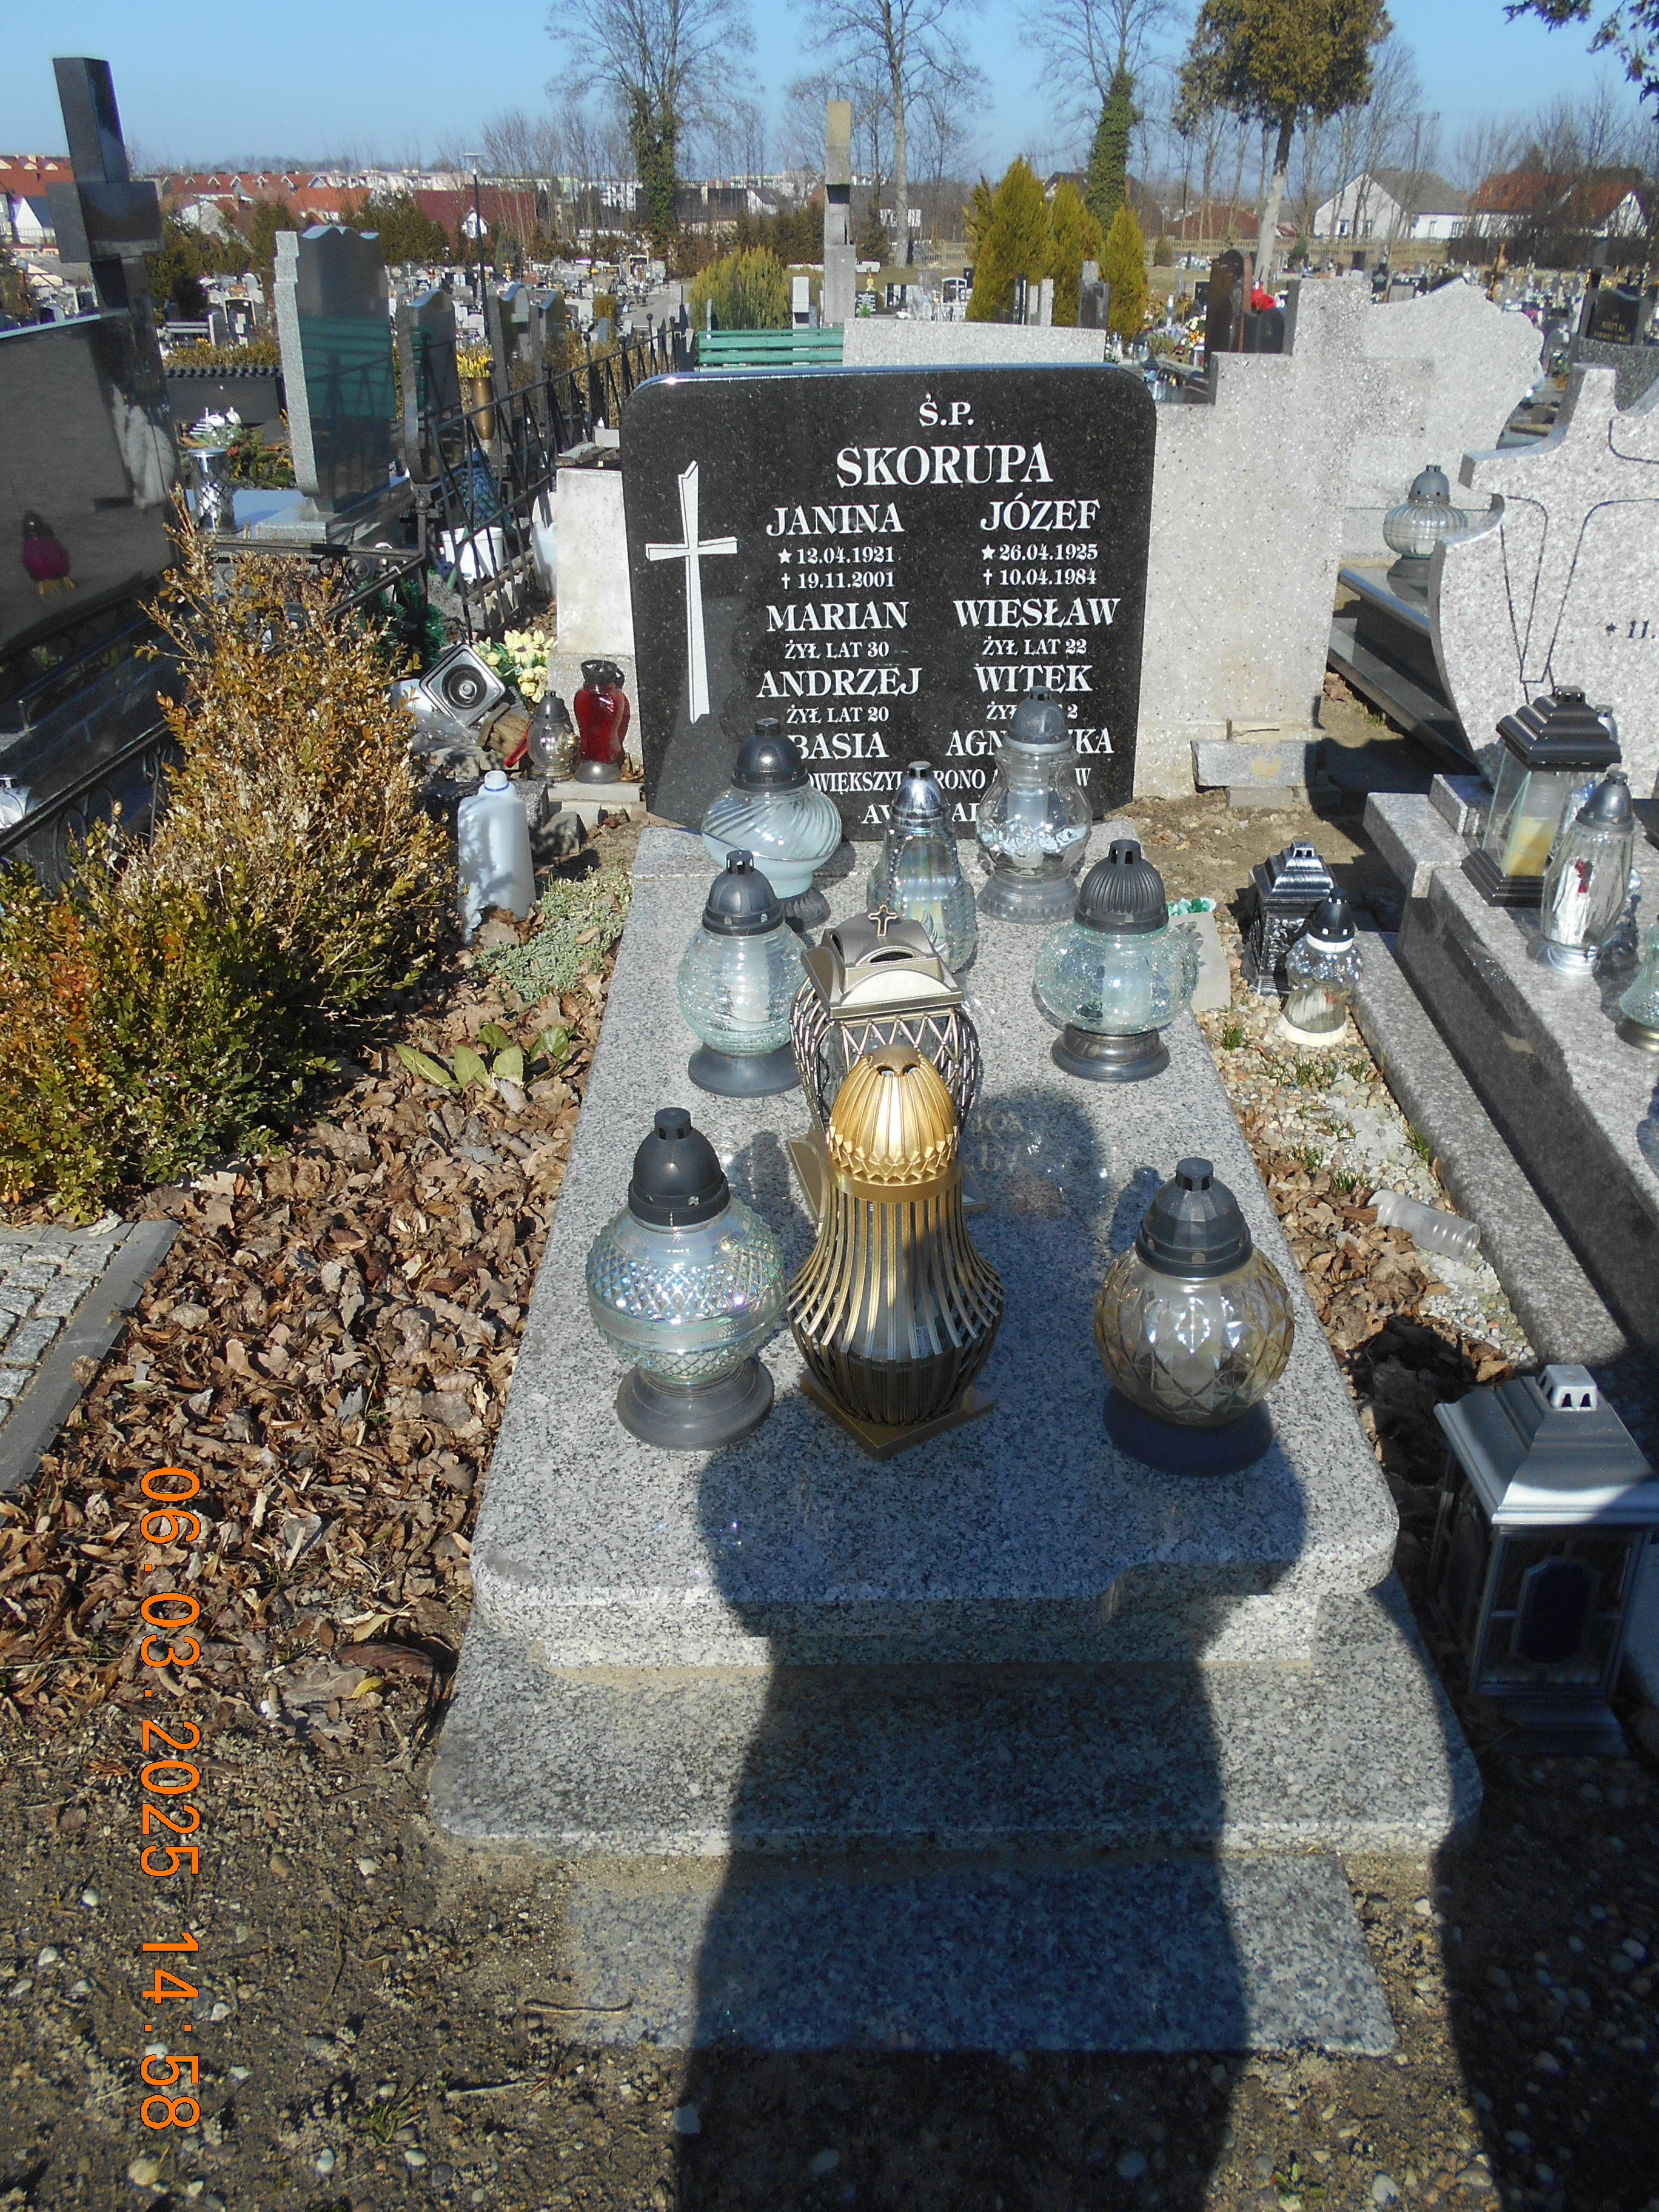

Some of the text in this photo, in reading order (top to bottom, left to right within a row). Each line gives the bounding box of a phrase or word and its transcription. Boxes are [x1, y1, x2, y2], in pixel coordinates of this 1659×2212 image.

[919, 393, 974, 427] Ś.P.
[836, 442, 1054, 489] SKORUPA
[766, 502, 905, 537] JANINA
[980, 492, 1101, 531] JÓZEF
[797, 546, 894, 564] 12.04.1921
[999, 543, 1098, 561] 26.04.1925
[798, 571, 894, 589] 19.11.2001
[999, 568, 1097, 585] 10.04.1984
[766, 600, 910, 632] MARIAN
[953, 597, 1121, 628] WIESŁAW
[785, 639, 890, 660] ŻYŁ LAT 30
[982, 635, 1087, 656] ŻYŁ LAT 22
[756, 667, 922, 698] ANDRZEJ
[973, 663, 1093, 694] WITEK
[786, 704, 890, 725] ŻYŁ LAT 20
[933, 768, 986, 789] RONO
